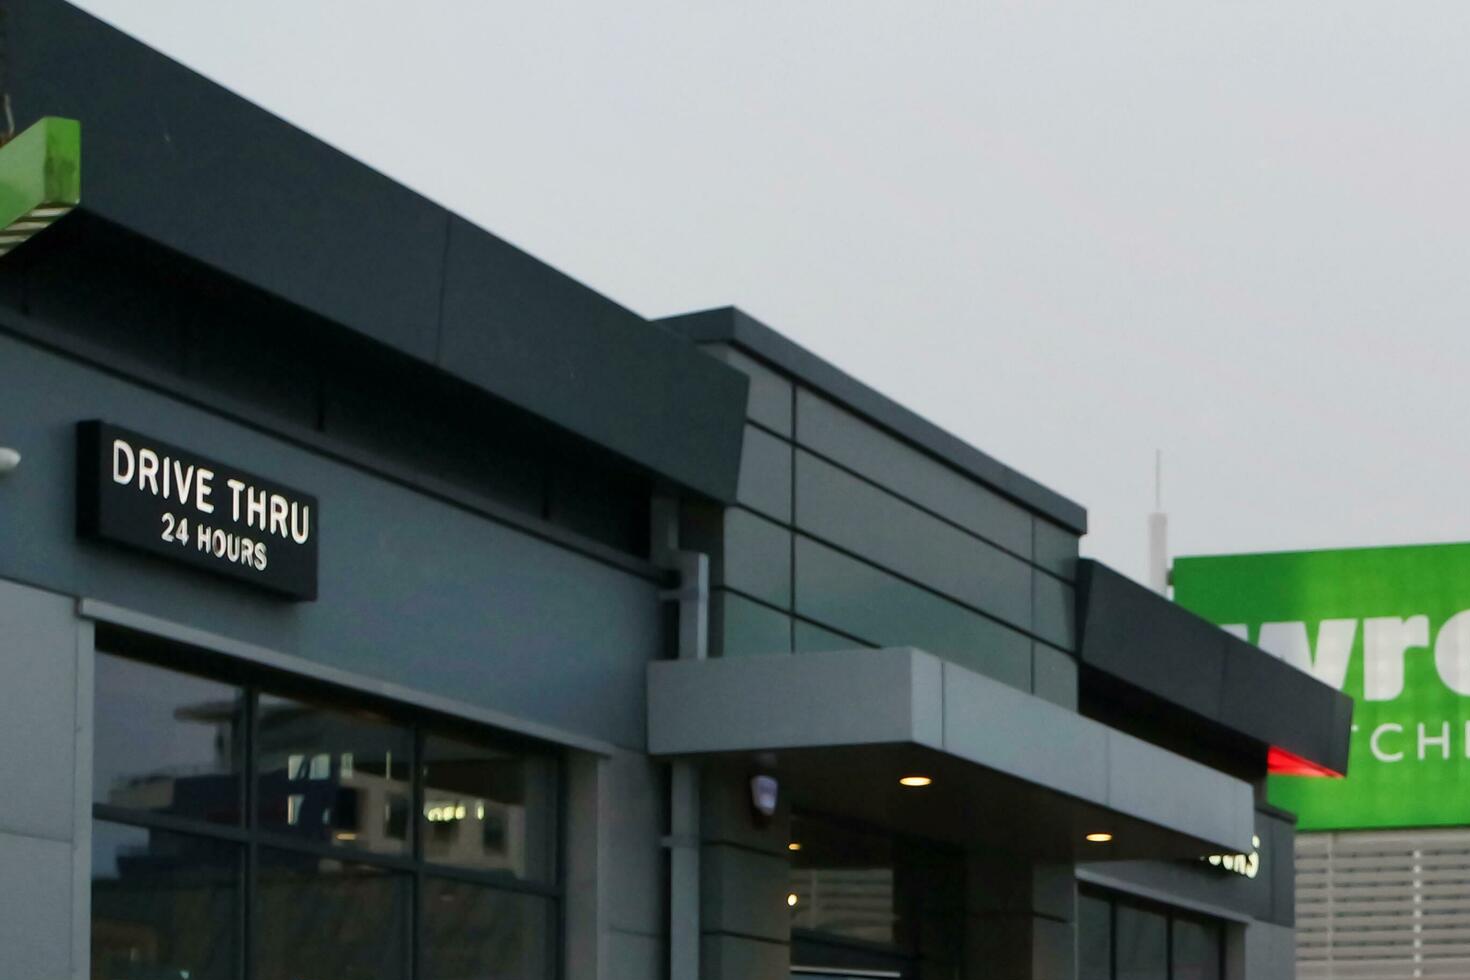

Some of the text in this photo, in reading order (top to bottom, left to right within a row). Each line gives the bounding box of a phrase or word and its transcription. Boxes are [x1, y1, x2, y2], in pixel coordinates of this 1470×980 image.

[112, 439, 310, 545] DRIVE THRU
[161, 512, 268, 572] 24 HOURS
